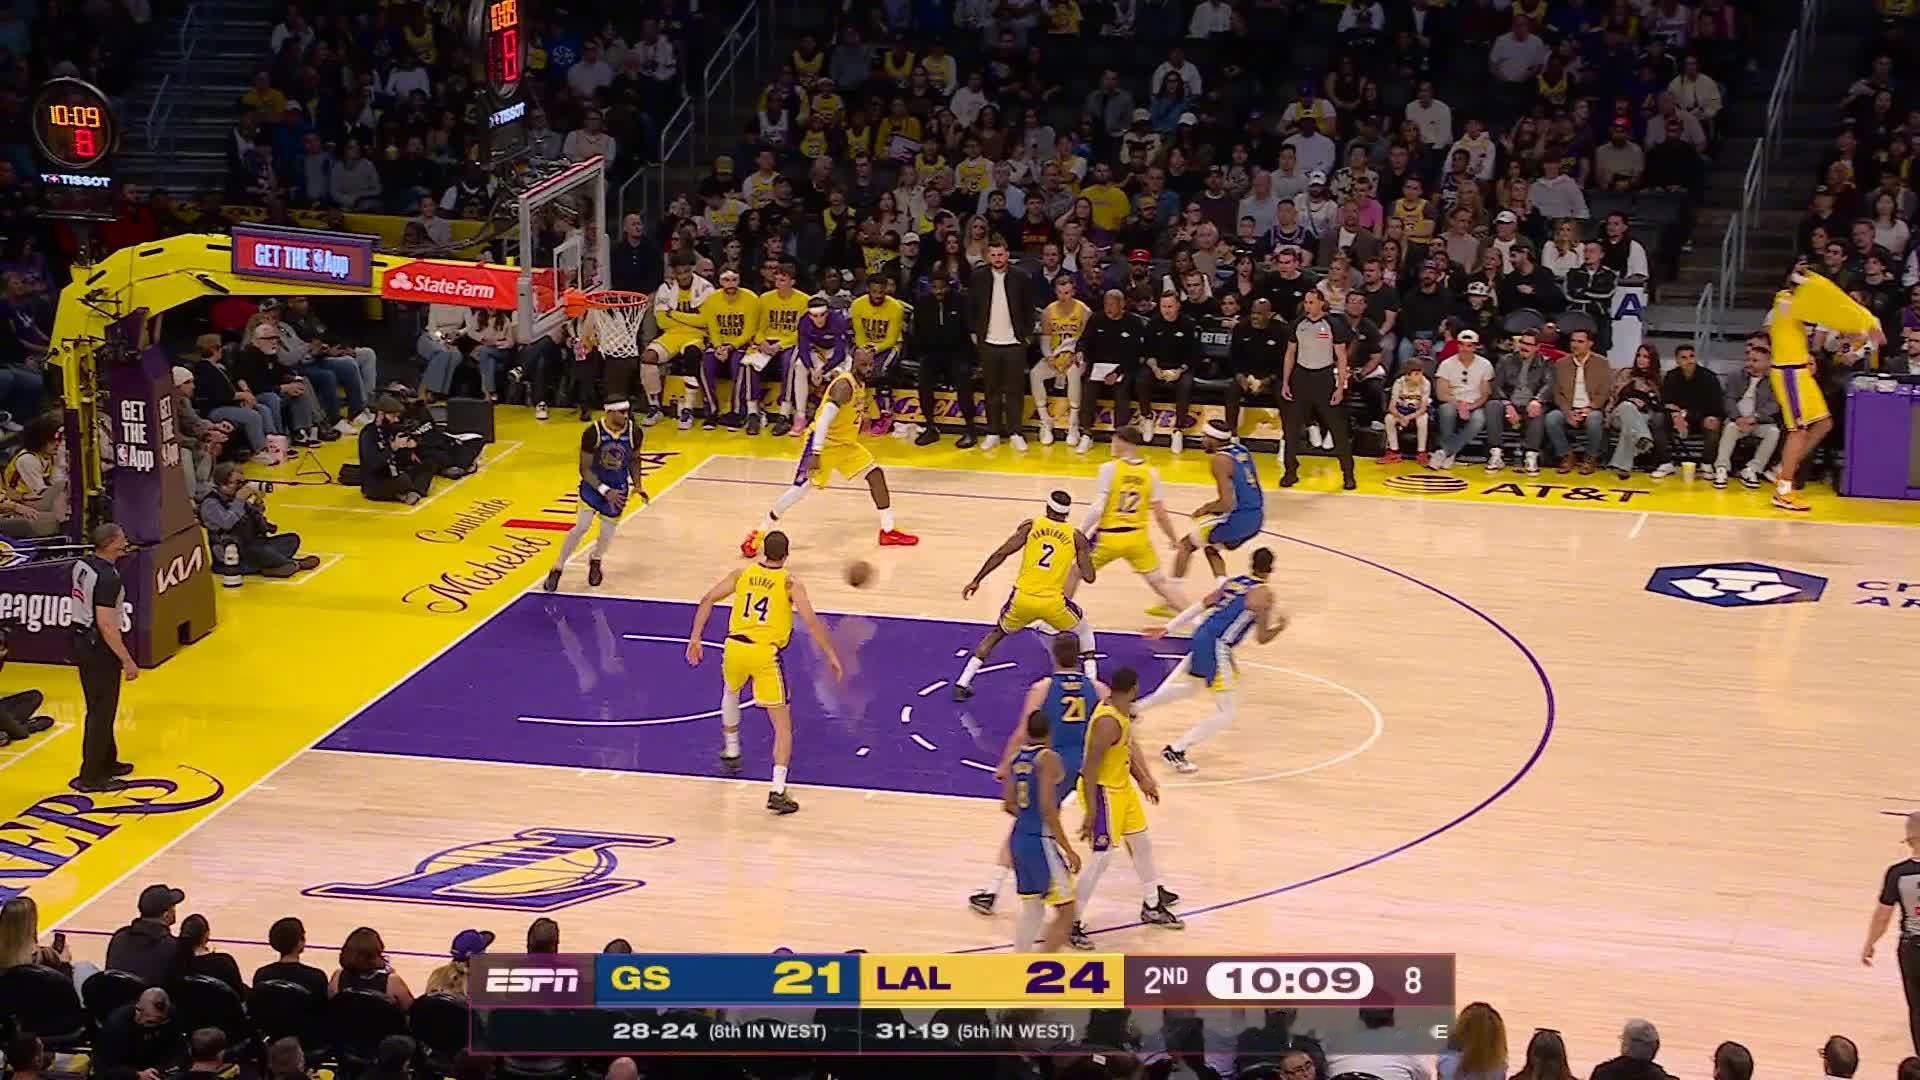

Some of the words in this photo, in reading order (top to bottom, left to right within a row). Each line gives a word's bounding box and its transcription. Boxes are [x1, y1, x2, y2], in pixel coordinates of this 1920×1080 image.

[49, 105, 101, 128] 10:09
[75, 129, 96, 156] 8
[60, 175, 111, 187] TISSOT
[255, 243, 281, 268] GET
[283, 246, 311, 271] THE
[324, 249, 350, 279] App
[121, 399, 146, 421] GET
[121, 421, 148, 444] THE
[129, 444, 155, 471] App
[1480, 483, 1651, 503] AT&T
[1039, 543, 1055, 568] 2
[402, 533, 552, 614] Michelob
[0, 592, 73, 632] eague
[743, 592, 769, 622] 14
[1060, 695, 1086, 722] 21
